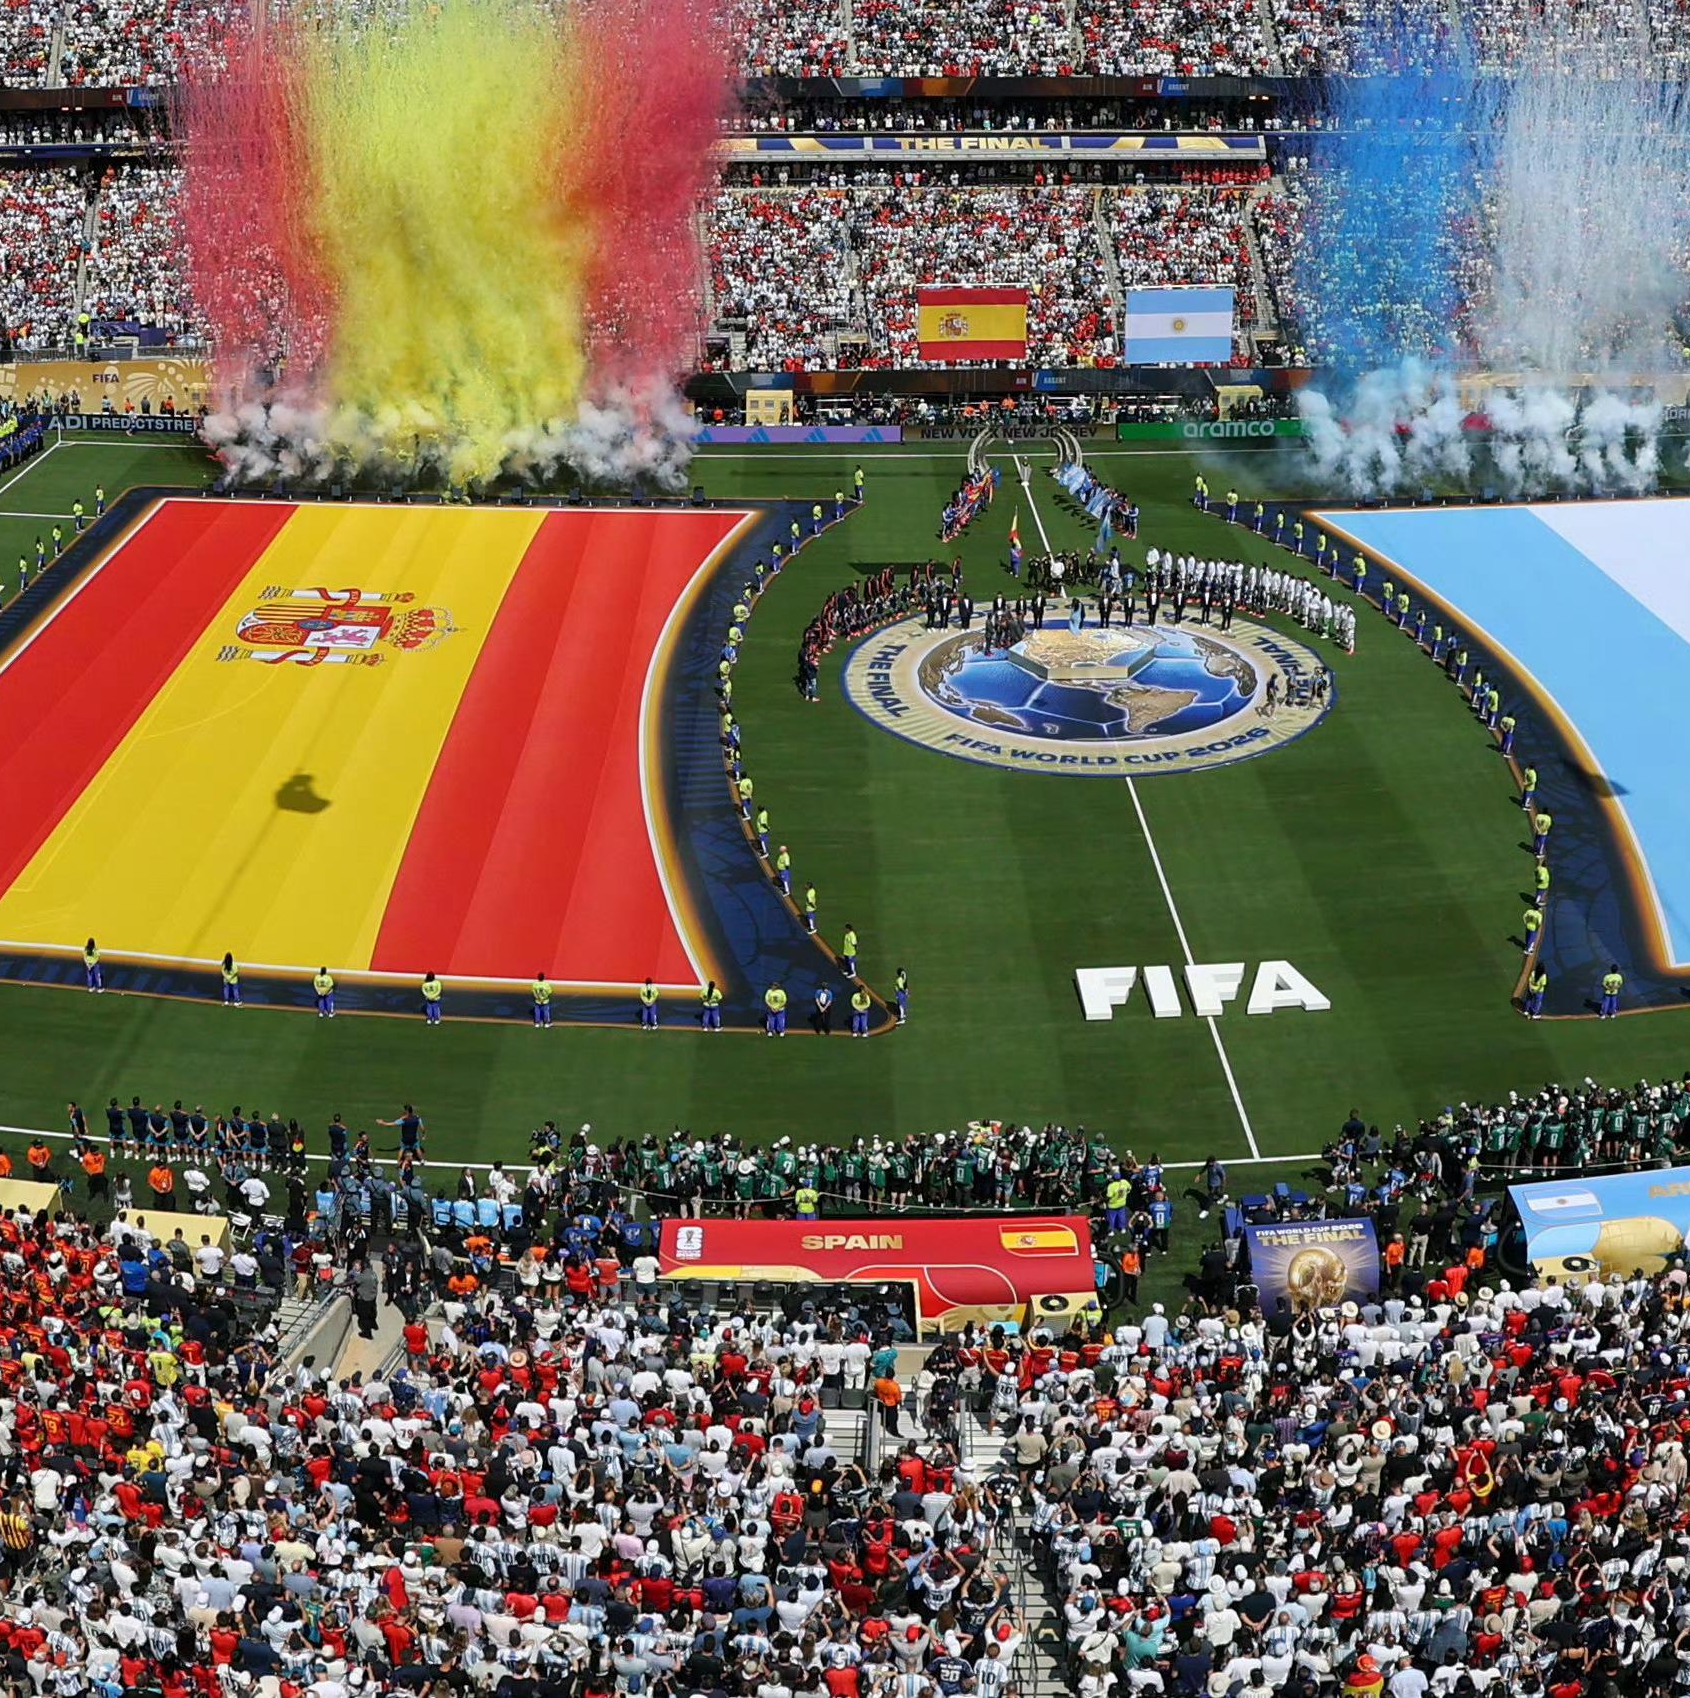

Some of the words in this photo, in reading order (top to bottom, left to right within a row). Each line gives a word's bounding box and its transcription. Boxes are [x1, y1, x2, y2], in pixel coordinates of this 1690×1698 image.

[895, 136, 955, 151] THE
[960, 136, 1051, 151] FINAL
[92, 373, 120, 384] FIFA
[47, 415, 88, 430] ADI
[92, 416, 194, 431] PREDCTSTRE
[1183, 420, 1276, 438] aramco
[920, 427, 956, 439] NEW
[959, 426, 1001, 439] YOK
[1002, 427, 1038, 439] NEW
[867, 643, 909, 670] THE
[866, 672, 911, 718] FINAL
[941, 732, 1003, 754] FIFA
[1010, 748, 1118, 766] WORLD
[1123, 750, 1182, 766] CUP
[1183, 726, 1271, 758] 2026
[1074, 959, 1332, 1021] FIFA
[1255, 1229, 1277, 1238] FIFA
[1276, 1227, 1311, 1236] WORLD
[1311, 1225, 1331, 1233] CUP
[1331, 1223, 1365, 1232] 2026
[1256, 1233, 1303, 1247] THE
[1304, 1229, 1369, 1244] FINAL
[800, 1234, 903, 1251] SPAIN
[44, 1419, 58, 1434] 19
[107, 1413, 126, 1427] 24
[980, 1670, 997, 1686] 10
